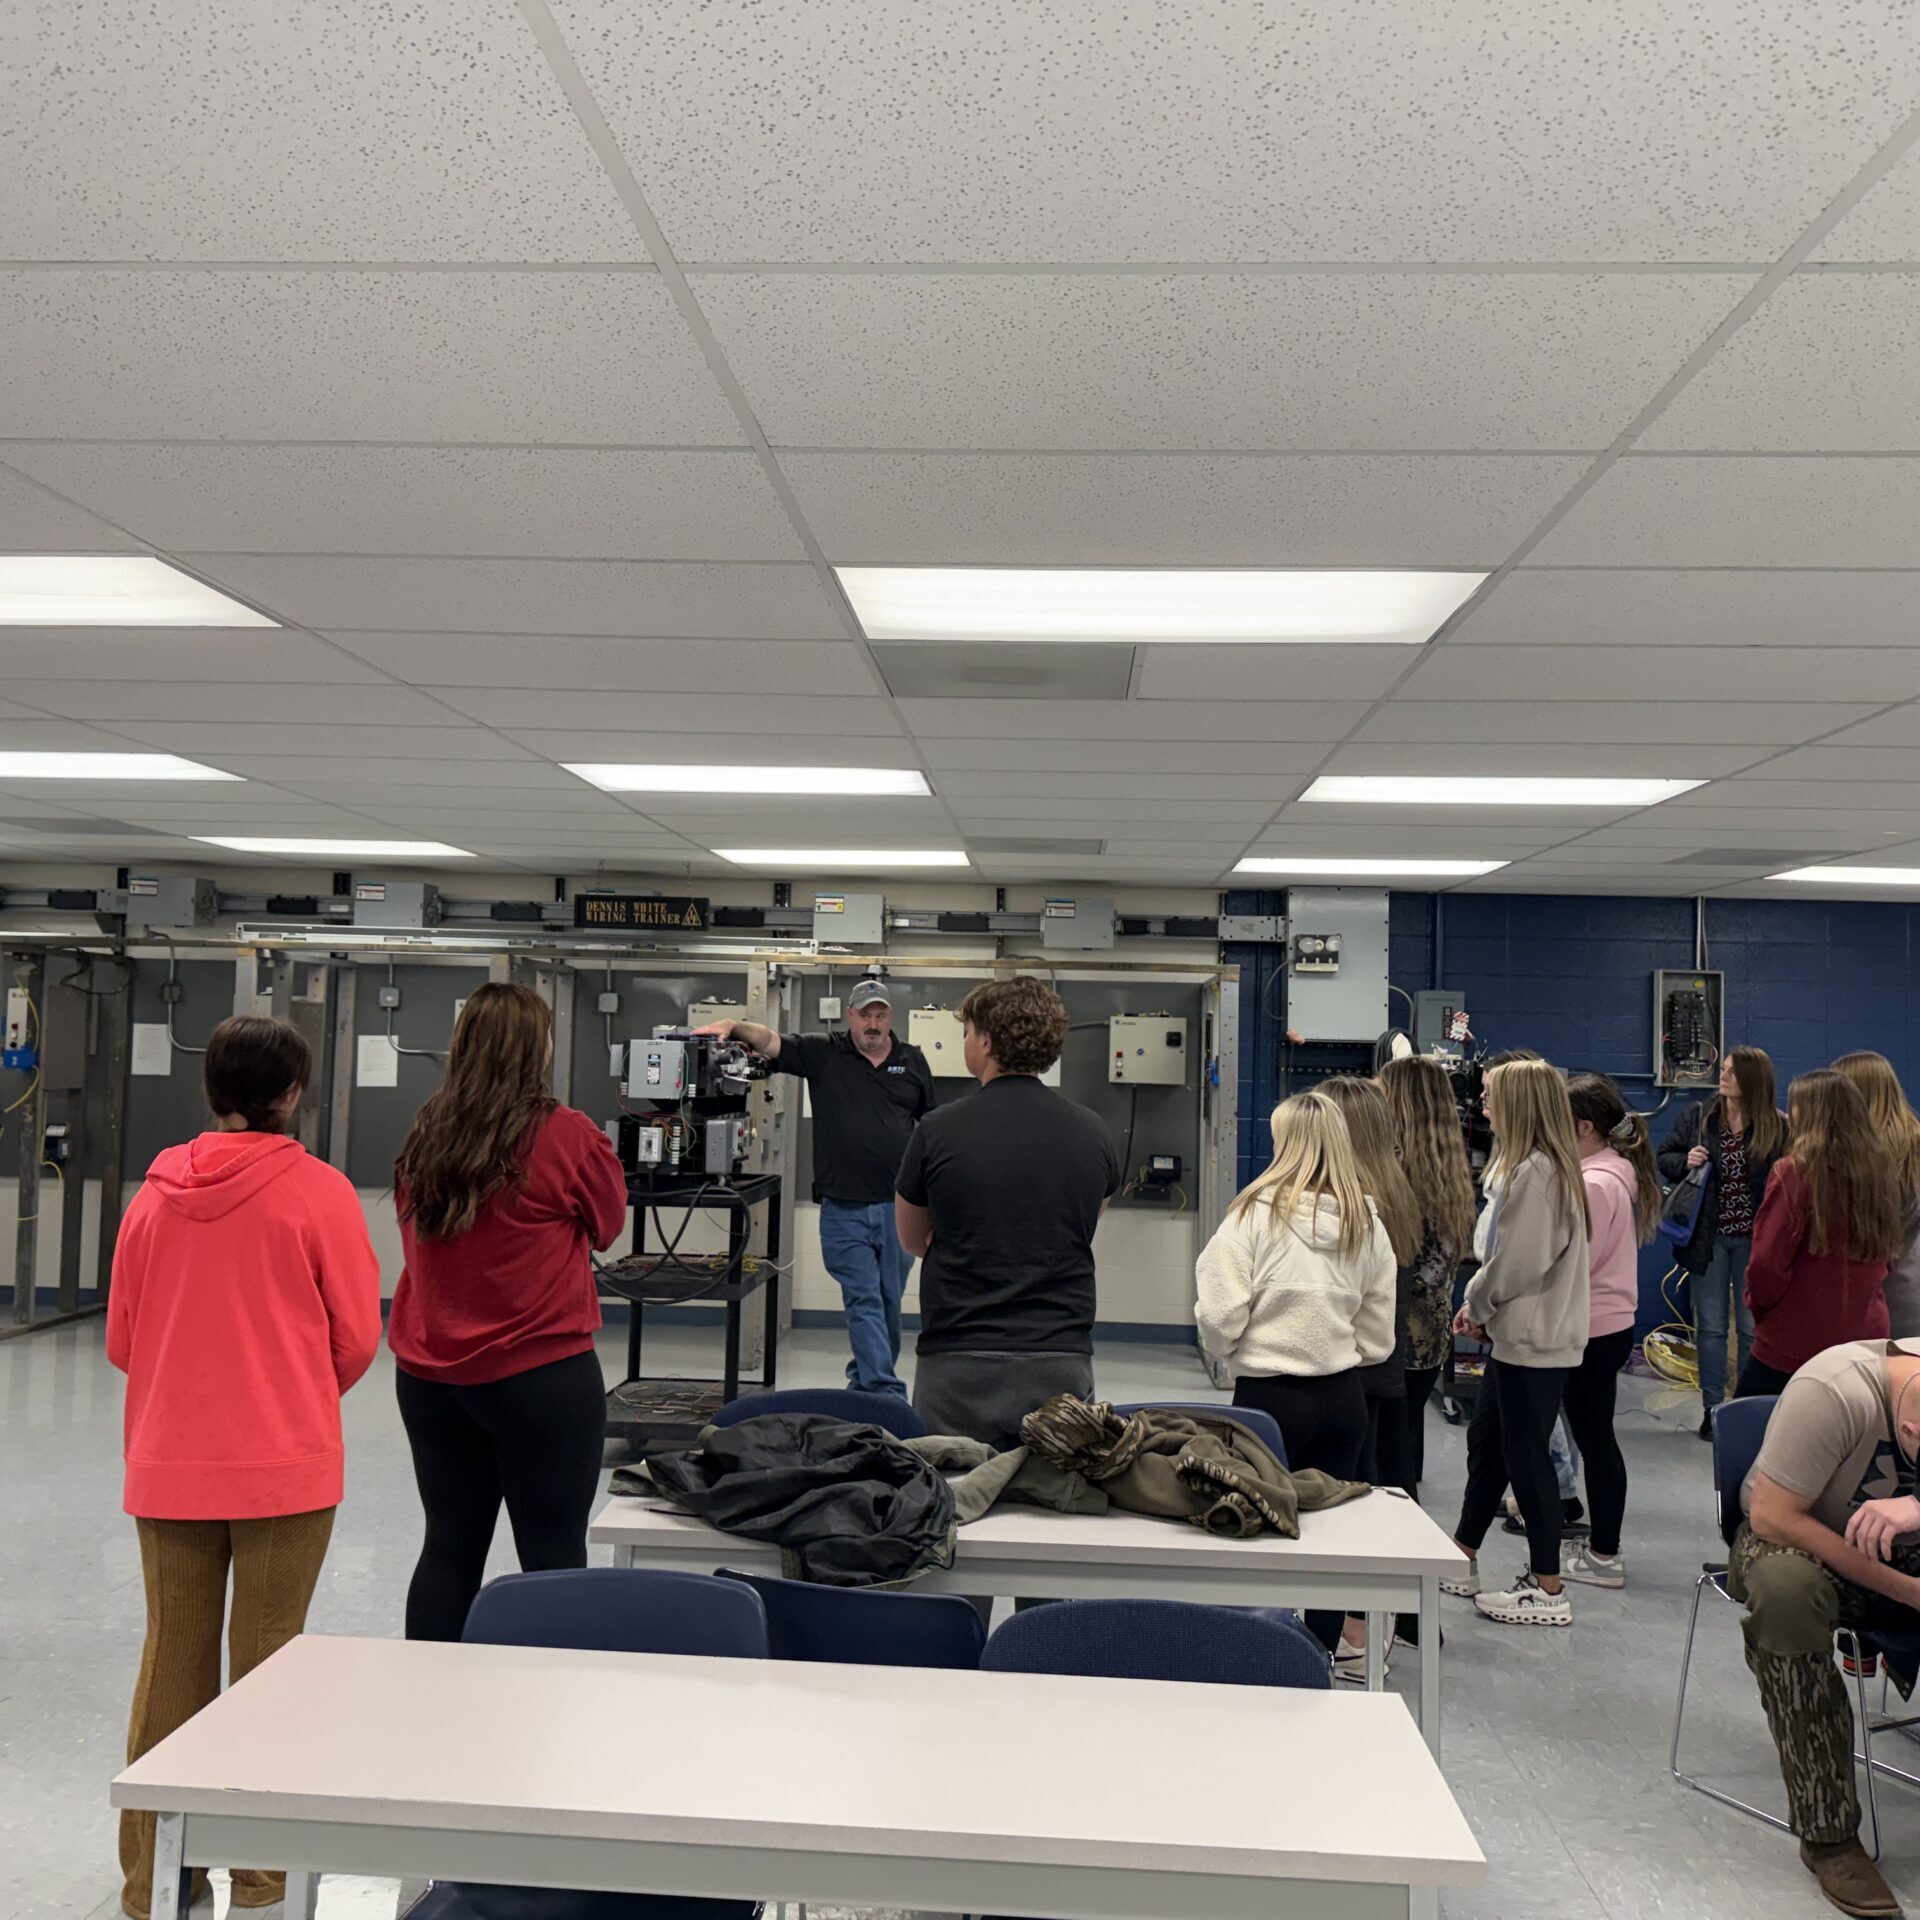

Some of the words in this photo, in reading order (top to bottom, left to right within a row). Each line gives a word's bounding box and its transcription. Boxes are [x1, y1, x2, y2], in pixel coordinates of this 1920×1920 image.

[586, 901, 626, 911] DENNIS
[633, 902, 668, 913] WHITE
[586, 911, 626, 922] WIRING
[633, 913, 681, 924] TRAINER
